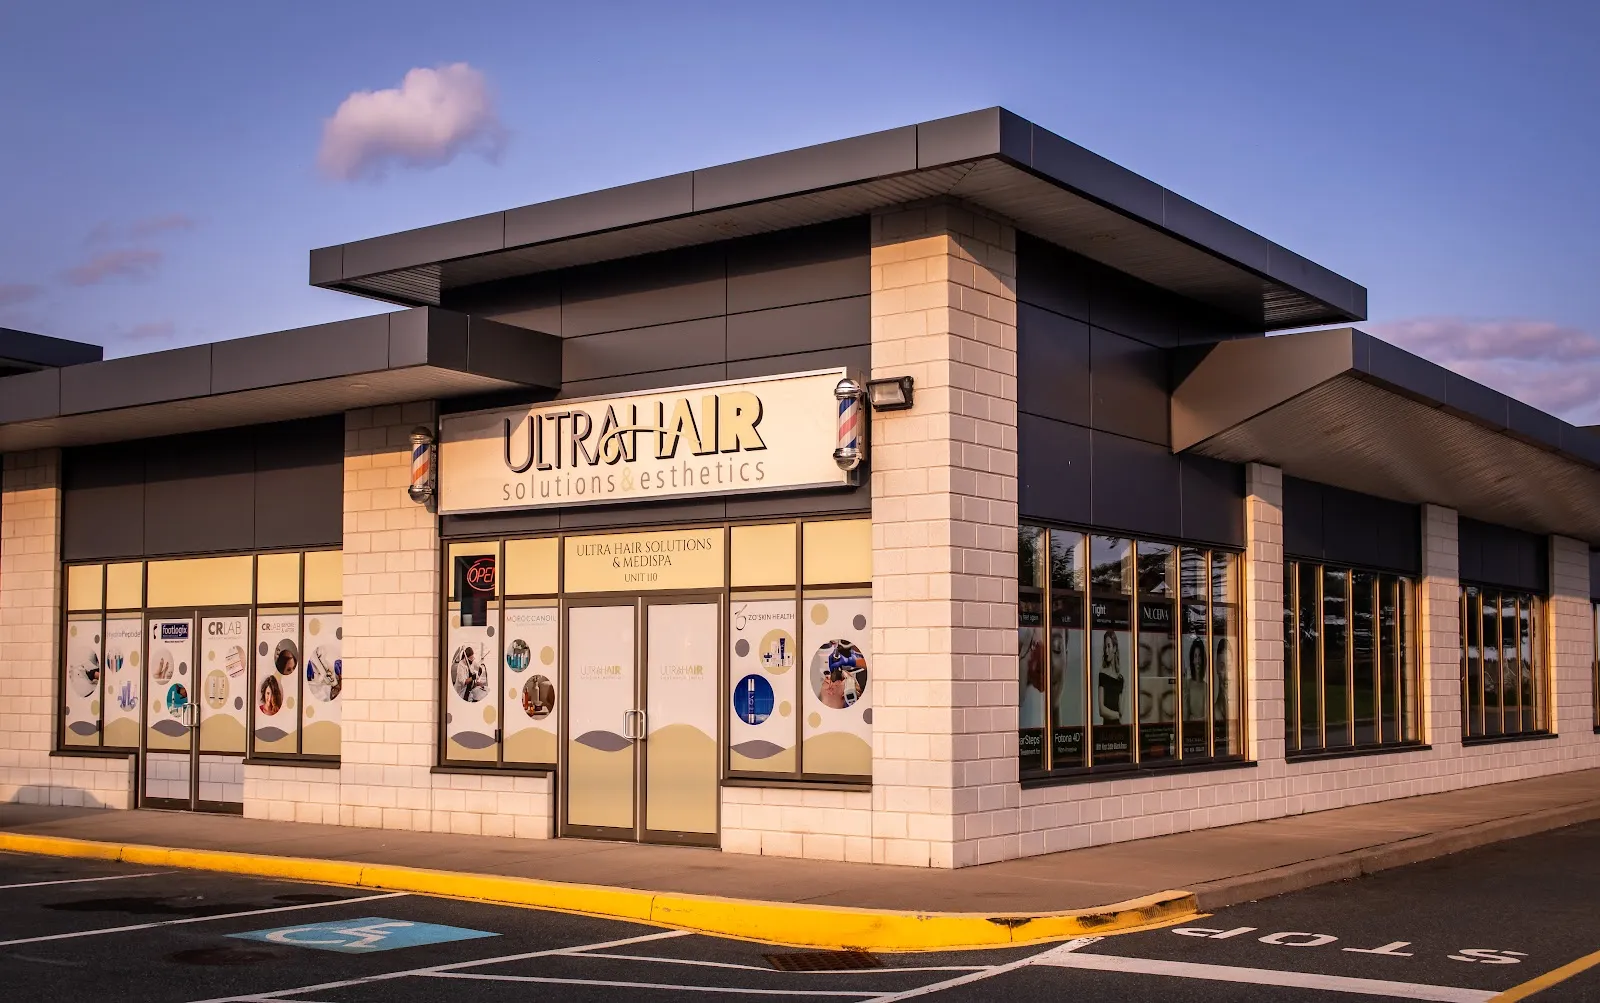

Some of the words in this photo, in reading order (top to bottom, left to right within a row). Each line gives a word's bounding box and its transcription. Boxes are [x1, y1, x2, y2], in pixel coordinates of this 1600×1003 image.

[503, 472, 615, 500] solutions
[621, 467, 635, 492] &
[640, 457, 765, 490] esthetics
[577, 544, 611, 556] ULTRA
[614, 541, 642, 555] HAIR
[645, 538, 712, 553] SOLUTIONS
[612, 556, 621, 568] &
[623, 554, 672, 568] MEDISPA
[624, 573, 645, 582] UNIT
[1171, 927, 1529, 965] STOP
